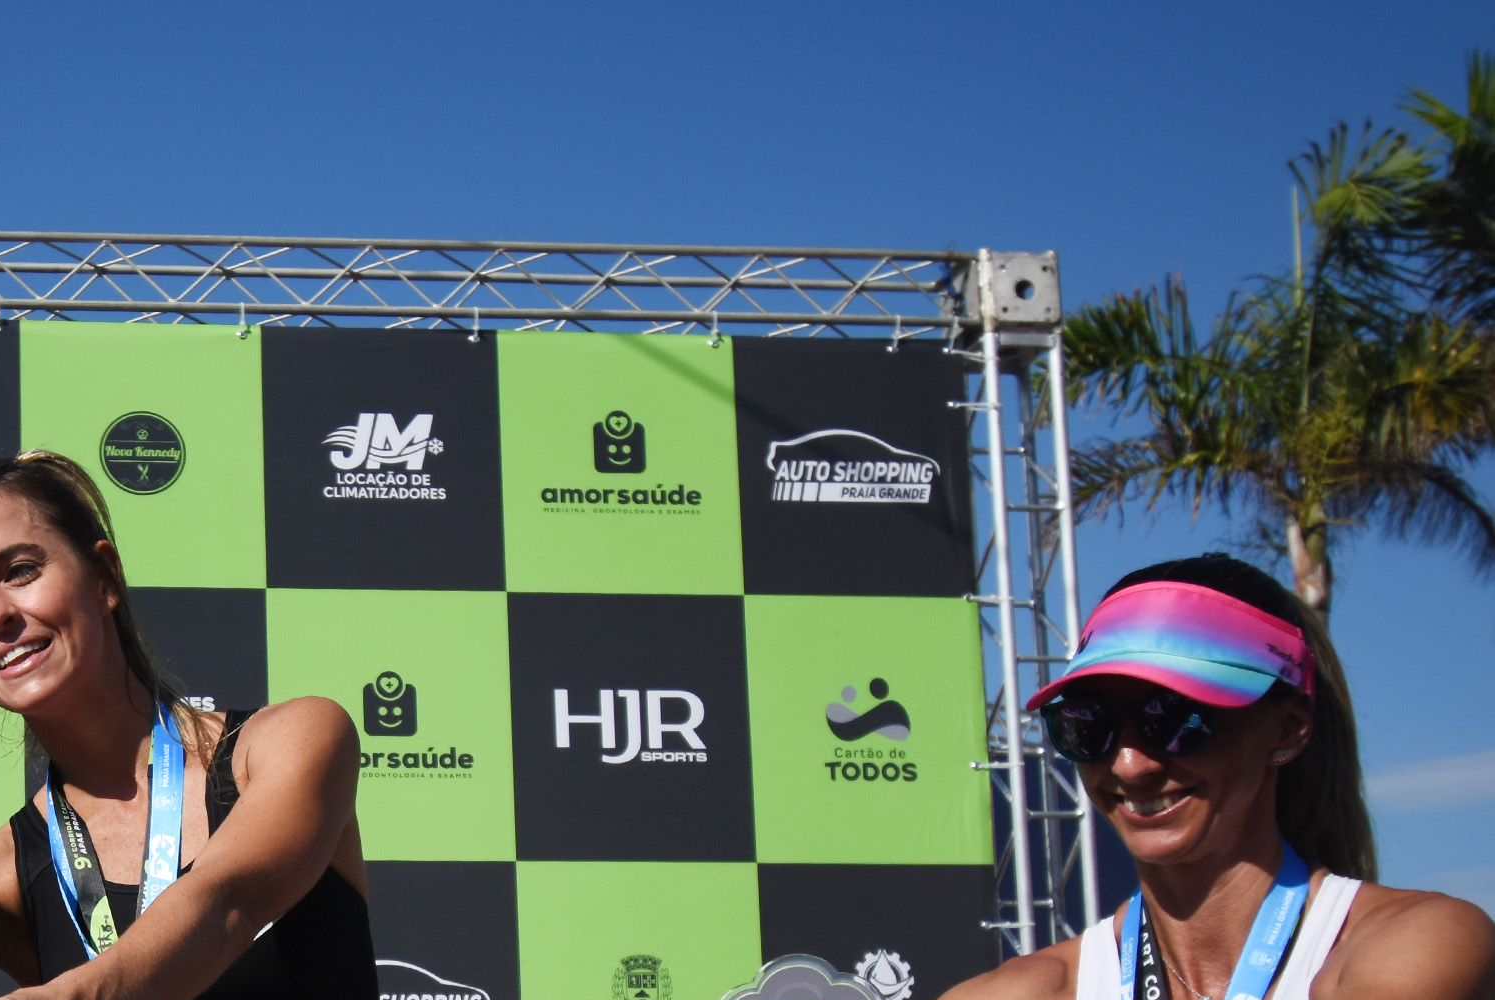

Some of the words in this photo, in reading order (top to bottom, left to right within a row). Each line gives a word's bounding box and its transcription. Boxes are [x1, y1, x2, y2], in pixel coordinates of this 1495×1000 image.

[322, 413, 433, 470] JM
[105, 446, 133, 456] Nova
[135, 446, 180, 460] Kennedy
[337, 471, 407, 486] LOCAÇÃO
[412, 474, 430, 486] DE
[776, 460, 830, 481] AUTO
[833, 462, 933, 483] SHOPPING
[323, 486, 446, 500] CLIMATIZADORES
[541, 484, 702, 505] amorsaúde
[841, 487, 877, 498] PRAIA
[879, 488, 927, 499] GRANDE
[554, 689, 707, 764] HJR
[641, 752, 707, 762] SPORTS
[835, 747, 883, 758] Cartão
[889, 748, 906, 759] de
[825, 761, 918, 782] TODOS
[66, 820, 77, 852] CORRIDA
[75, 831, 87, 854] APAE
[1268, 920, 1281, 945] PRAIA
[1278, 890, 1295, 922] GRANDE
